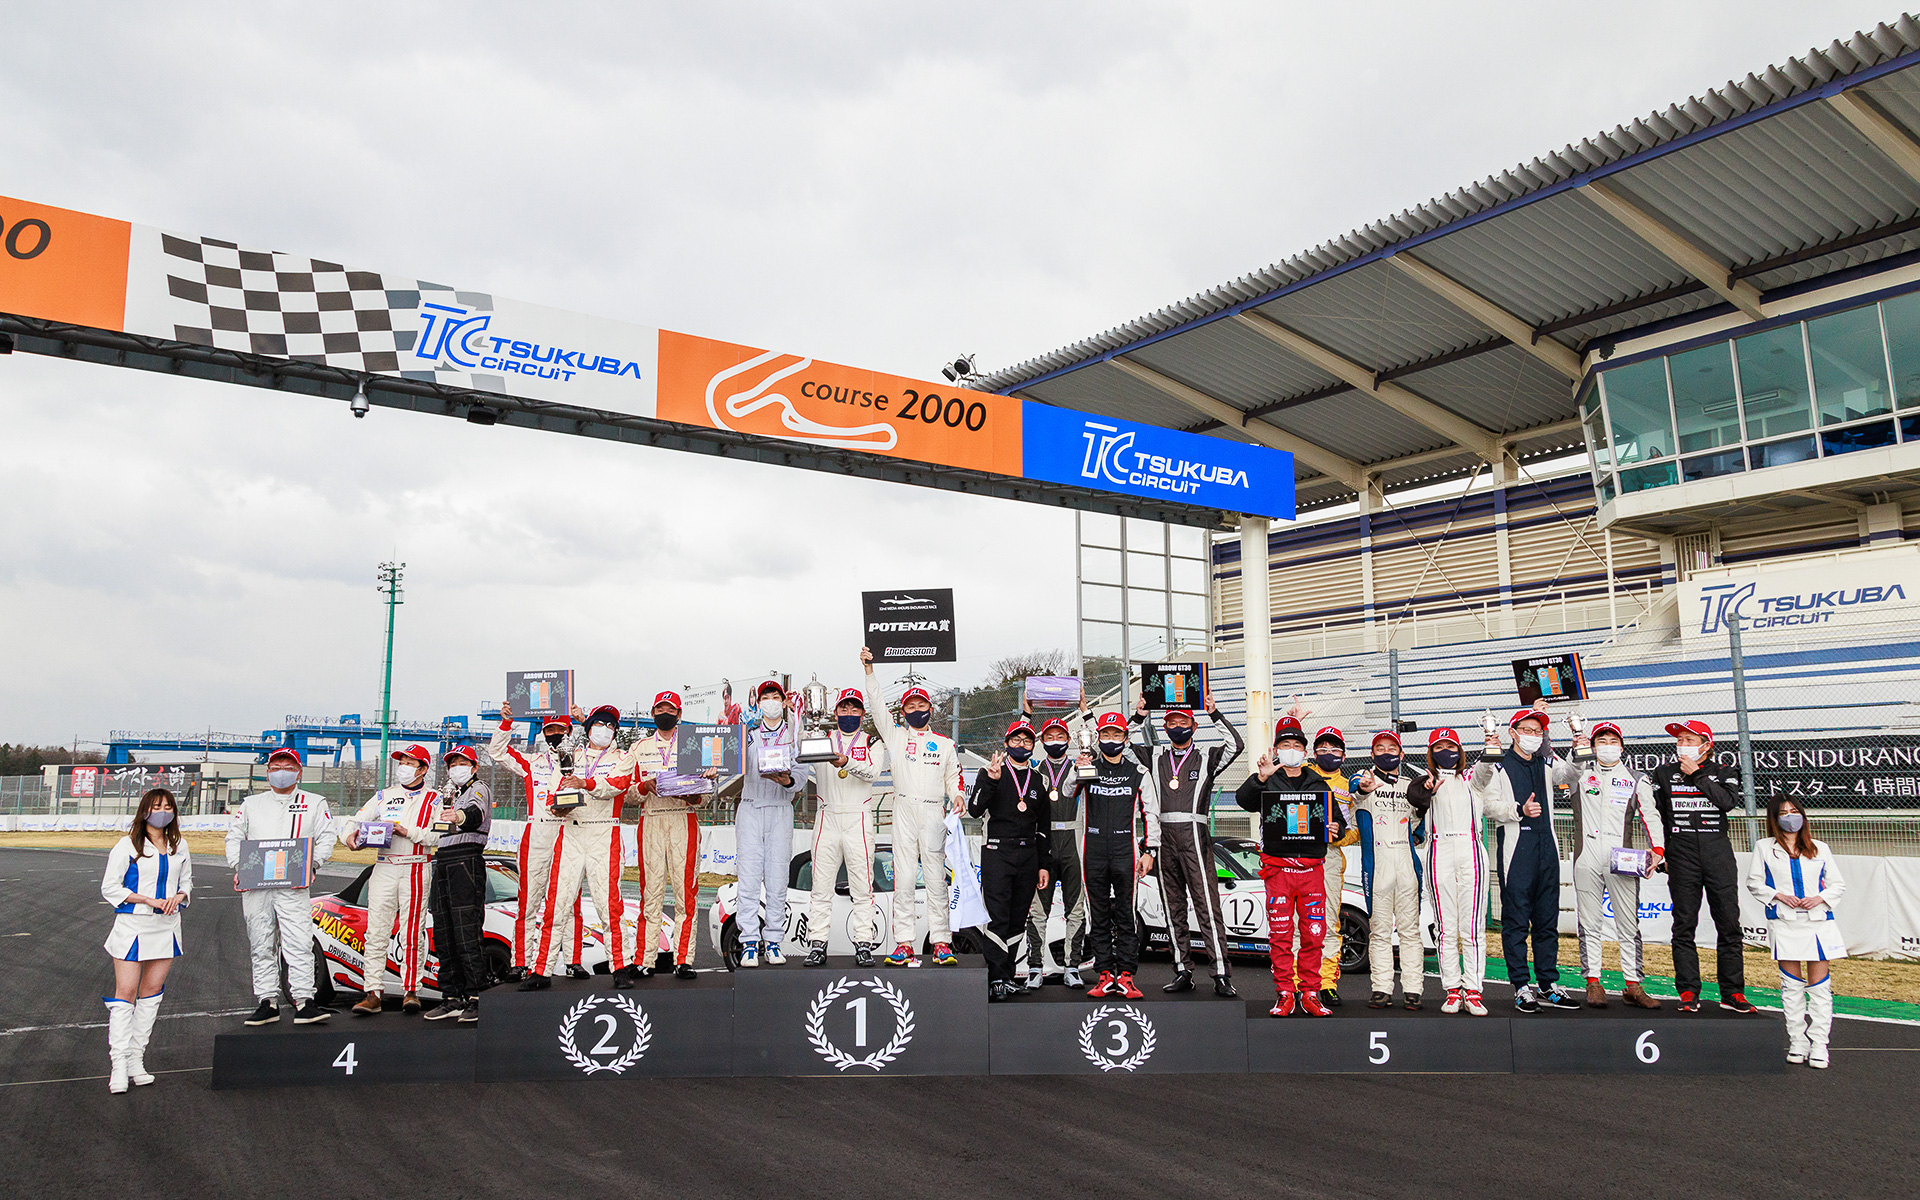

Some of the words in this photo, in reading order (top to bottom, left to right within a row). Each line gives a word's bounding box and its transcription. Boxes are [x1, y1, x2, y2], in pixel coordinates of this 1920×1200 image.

[0, 215, 51, 260] 0
[489, 336, 641, 380] TSUKUBA
[801, 381, 889, 411] course
[896, 389, 987, 432] 2000
[1134, 451, 1249, 488] TSUKUBA
[1758, 584, 1906, 613] TSUKUBA
[884, 646, 937, 657] BRIDGESTONE
[103, 766, 186, 787] トラスト企画
[1089, 784, 1132, 796] mazda
[1675, 800, 1698, 809] FUCKIN
[1229, 898, 1256, 926] 12
[350, 937, 365, 952] 81.
[351, 957, 365, 969] FUT
[589, 1014, 620, 1055] 2
[845, 997, 867, 1047] 1
[1106, 1019, 1130, 1056] 3
[332, 1042, 359, 1075] 4
[1369, 1031, 1391, 1065] 5
[1635, 1029, 1661, 1064] 6
